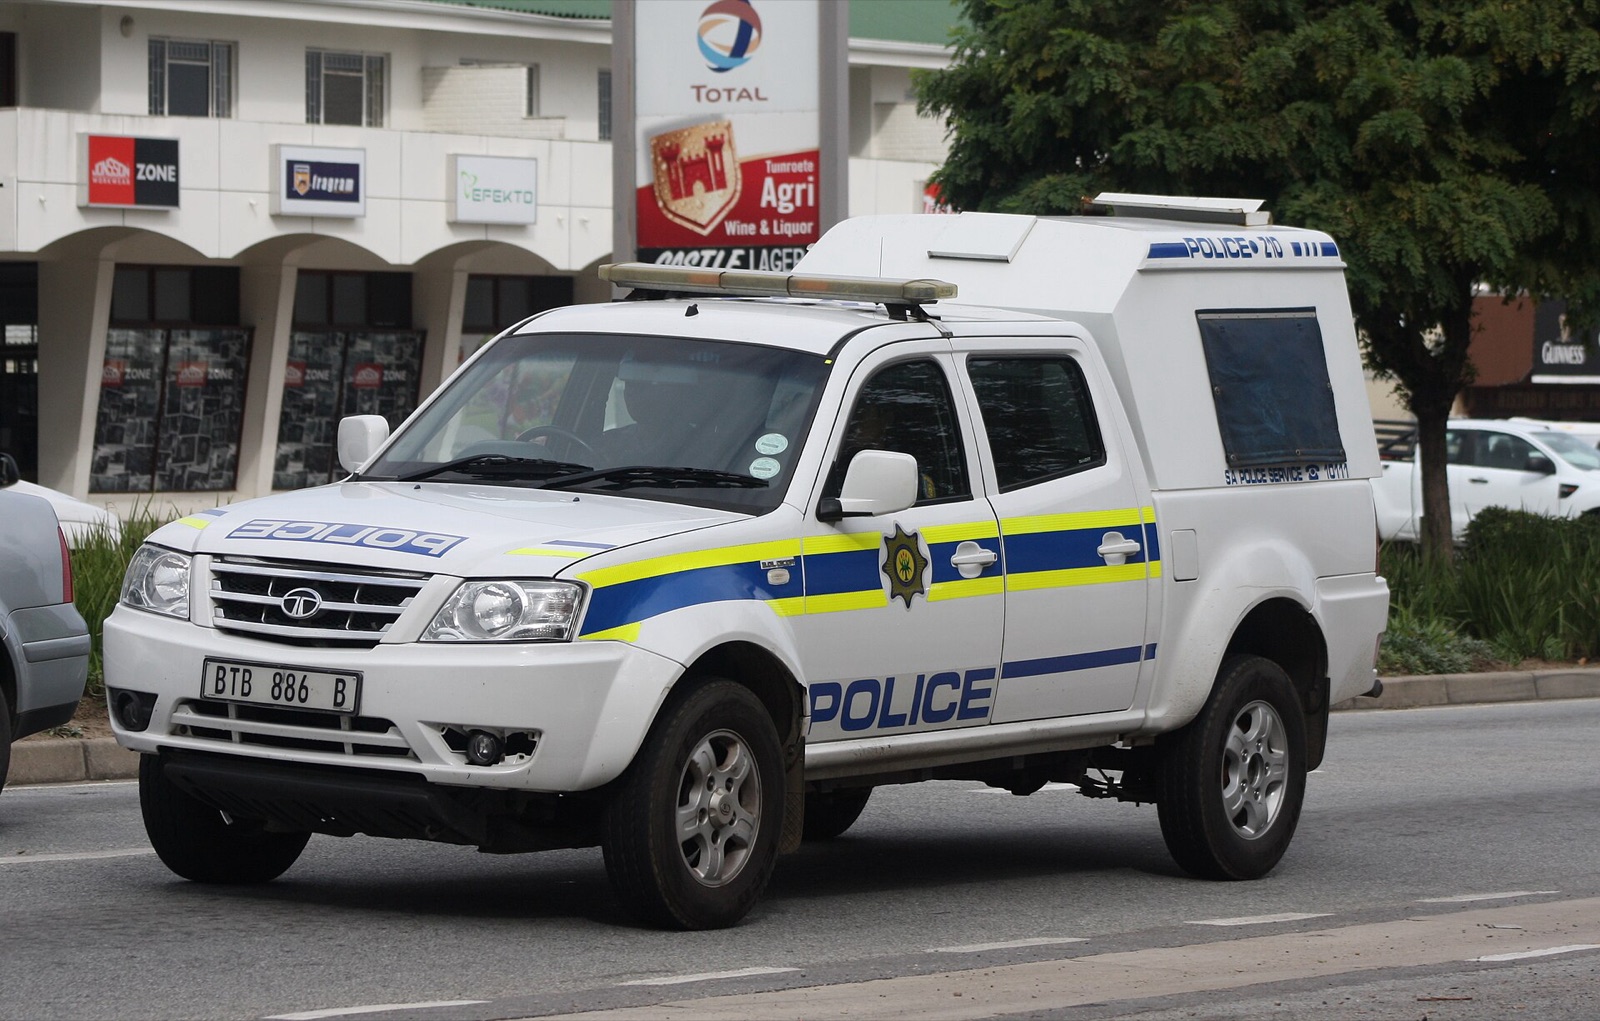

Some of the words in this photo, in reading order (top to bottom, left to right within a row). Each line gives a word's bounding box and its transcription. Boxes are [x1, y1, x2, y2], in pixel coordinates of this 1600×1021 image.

[690, 85, 768, 103] TOTAL
[136, 163, 176, 182] ZONE
[472, 188, 533, 204] EFEKTO
[760, 176, 814, 214] Agri
[724, 220, 756, 236] Wine
[760, 219, 770, 235] &
[773, 220, 813, 238] Liquor
[1182, 237, 1253, 259] POLICE
[1541, 341, 1585, 365] GUINNESS
[124, 368, 151, 380] ZONE
[207, 367, 233, 380] ZONE
[304, 369, 330, 381] ZONE
[383, 370, 407, 382] ZONE
[1225, 469, 1237, 485] SA
[1240, 467, 1267, 484] POLICE
[1268, 465, 1303, 482] SERVICE
[1324, 463, 1349, 480] 10111
[214, 665, 253, 698] BTB
[271, 671, 309, 704] 886
[333, 677, 347, 708] B
[808, 667, 996, 735] POLICE
